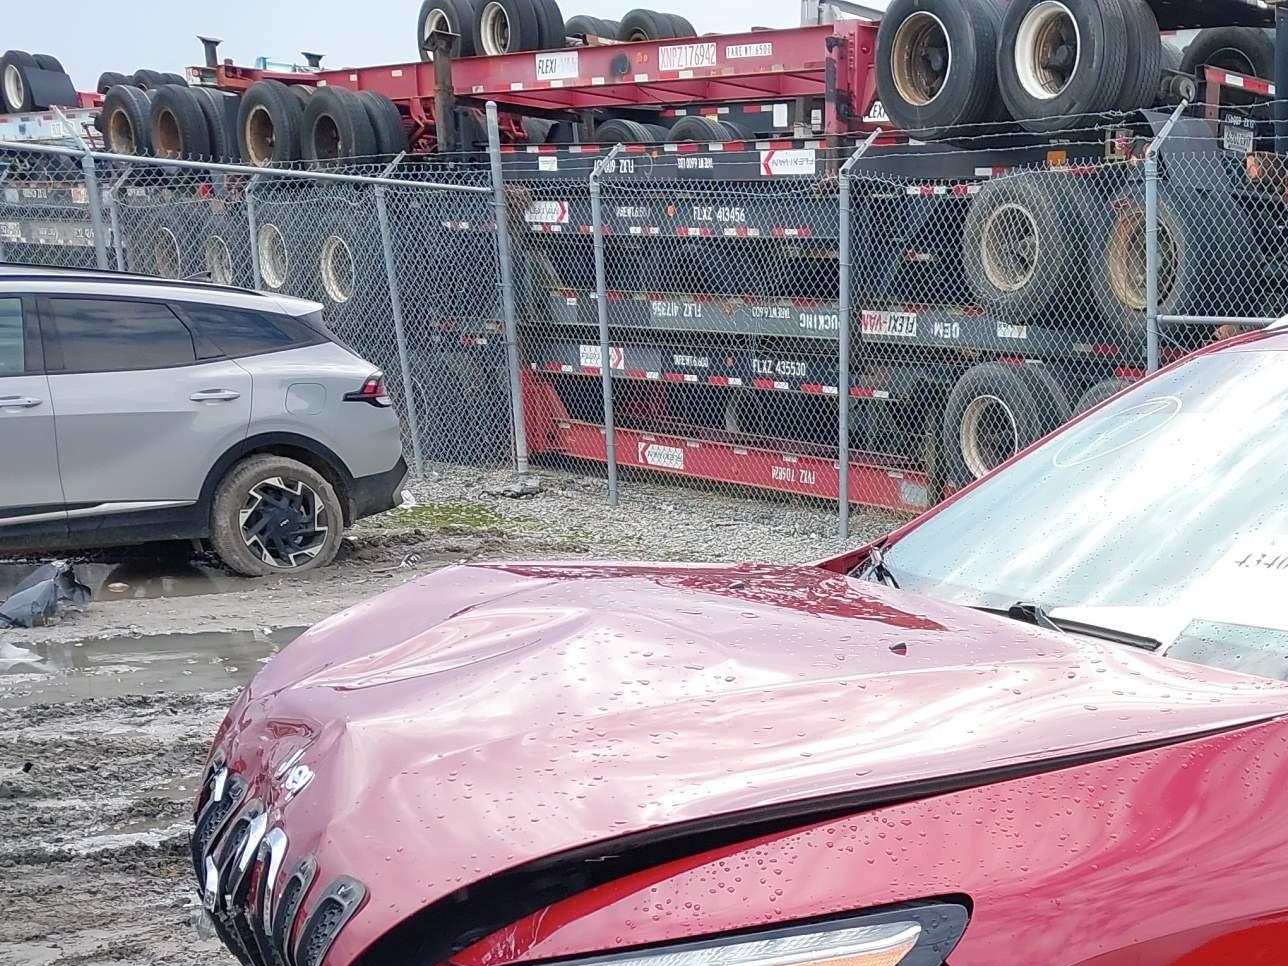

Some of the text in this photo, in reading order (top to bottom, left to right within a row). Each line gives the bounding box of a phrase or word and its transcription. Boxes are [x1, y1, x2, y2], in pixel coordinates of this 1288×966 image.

[619, 159, 635, 174] FLXZ
[693, 206, 746, 222] FLXZ 413456
[652, 302, 702, 318] FLXZ 417356
[752, 359, 806, 377] FLXZ 435530
